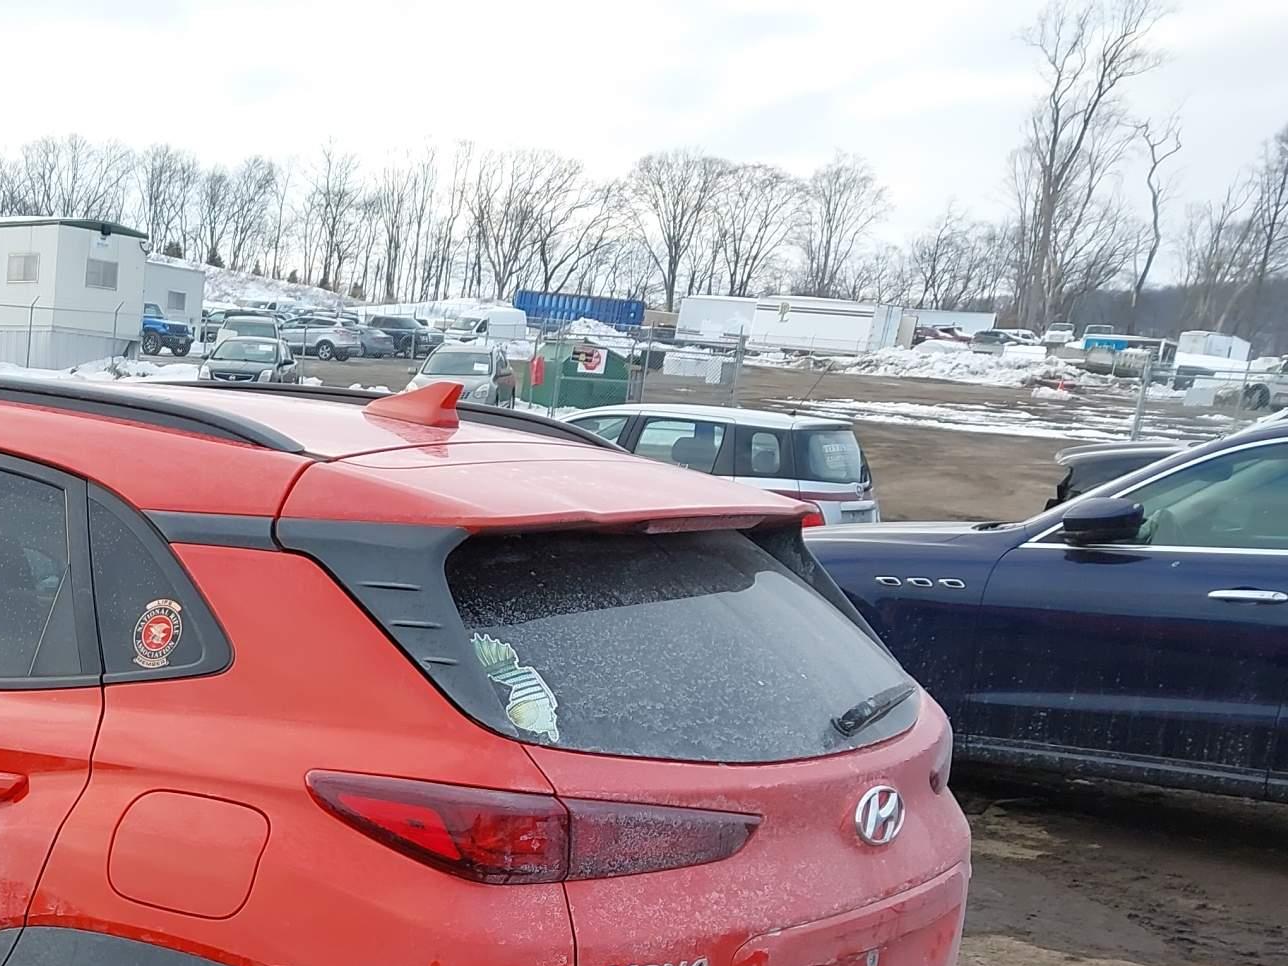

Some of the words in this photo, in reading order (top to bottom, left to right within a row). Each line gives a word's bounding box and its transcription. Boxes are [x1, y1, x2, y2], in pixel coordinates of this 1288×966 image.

[137, 608, 170, 632] NATIONAL
[169, 611, 180, 636] RIFLE
[136, 640, 175, 658] ASSOCIATION
